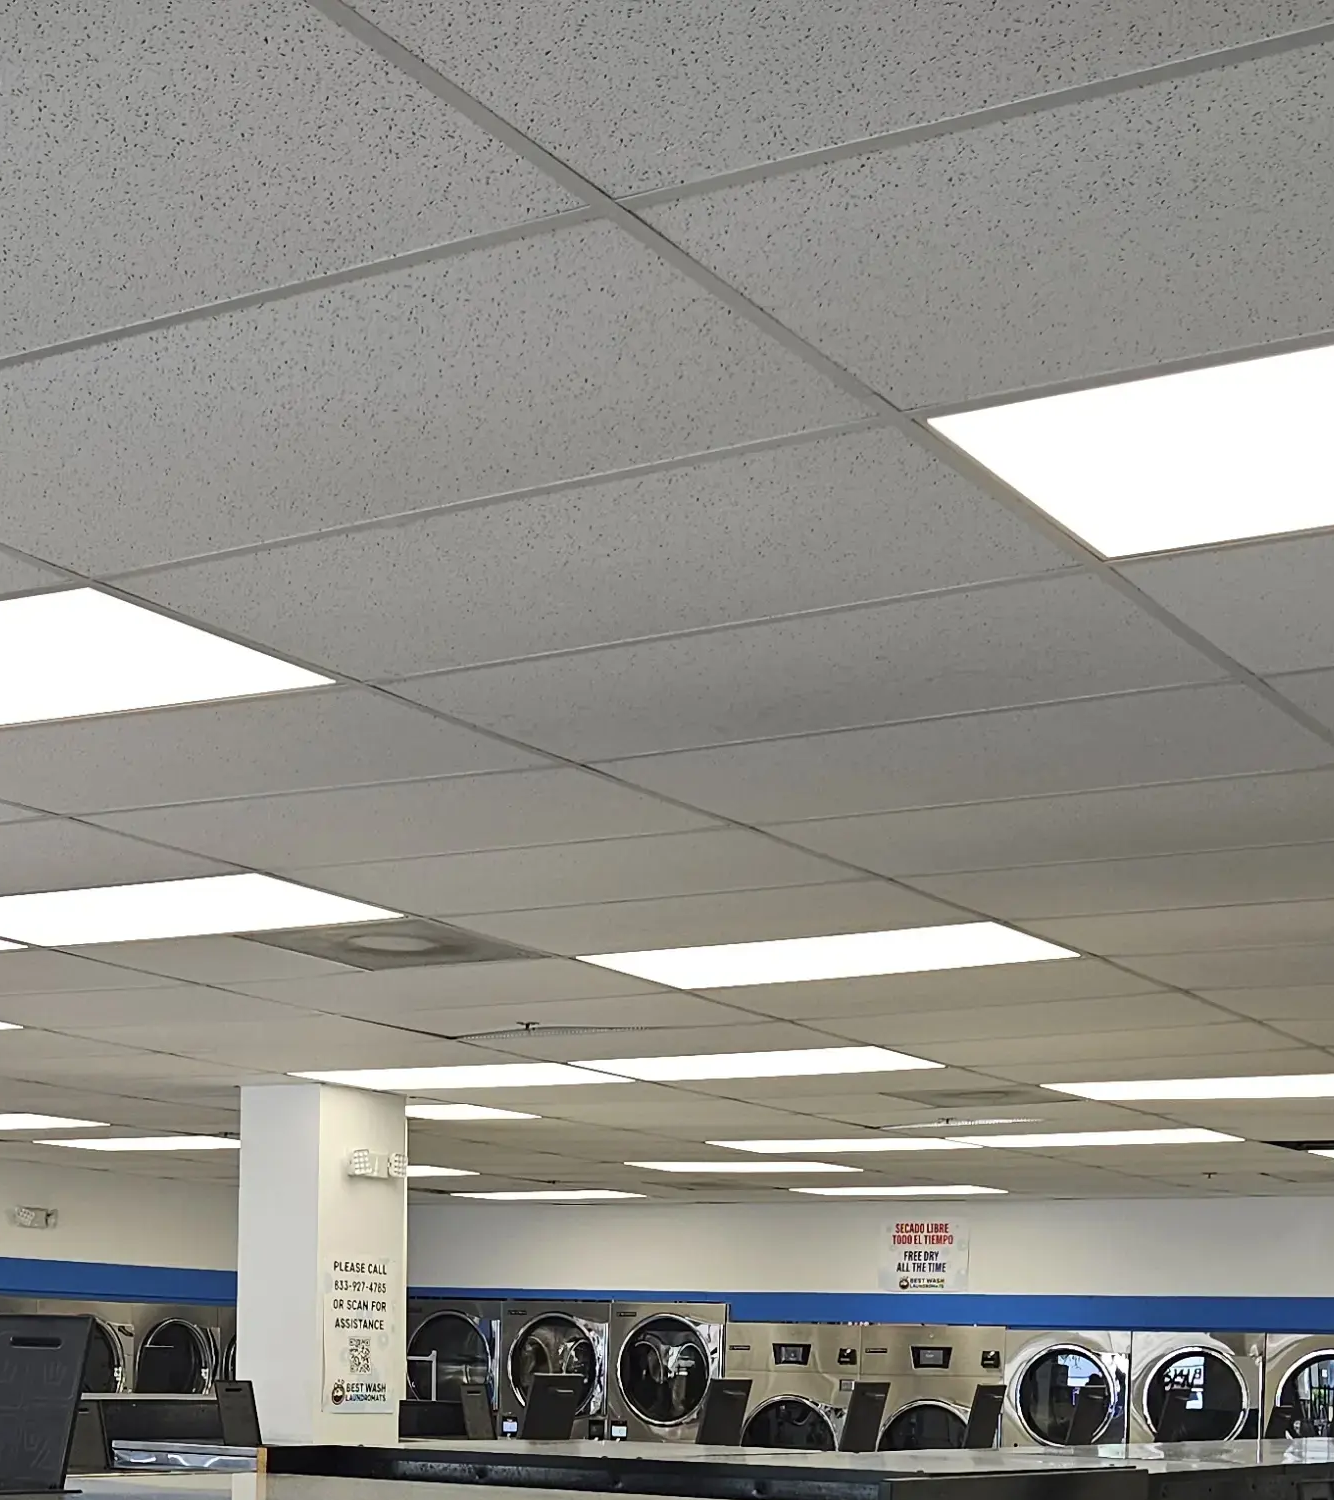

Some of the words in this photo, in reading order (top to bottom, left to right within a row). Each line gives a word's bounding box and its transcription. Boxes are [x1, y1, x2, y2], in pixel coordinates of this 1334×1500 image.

[895, 1223, 925, 1233] SECADO
[927, 1223, 949, 1233] LIBRE
[892, 1235, 912, 1244] TODO
[914, 1235, 922, 1244] EL
[924, 1235, 954, 1244] TIEMPO
[904, 1251, 922, 1261] FREE
[924, 1251, 939, 1261] DRY
[334, 1261, 365, 1273] PLEASE
[368, 1263, 387, 1275] CALL
[897, 1263, 910, 1272] ALL
[912, 1263, 926, 1272] THE
[928, 1263, 946, 1272] TIME
[333, 1299, 344, 1309] OR
[347, 1300, 368, 1311] SCAN
[371, 1301, 386, 1312] FOR
[335, 1318, 384, 1330] ASSISTANCE
[346, 1383, 364, 1392] BEST
[366, 1383, 386, 1392] WASH
